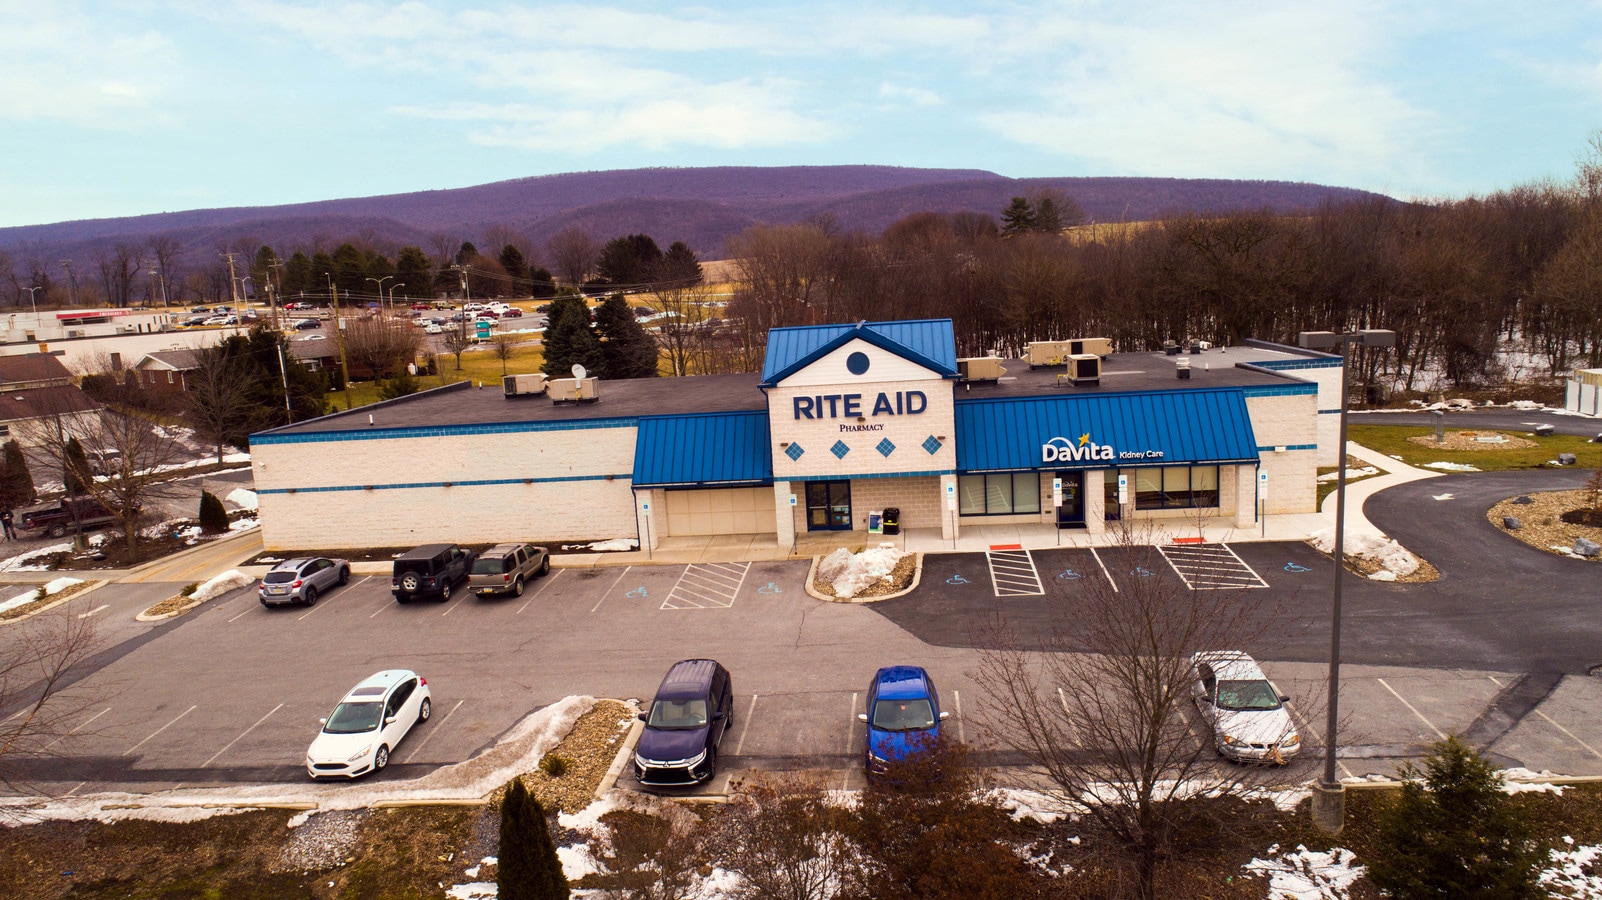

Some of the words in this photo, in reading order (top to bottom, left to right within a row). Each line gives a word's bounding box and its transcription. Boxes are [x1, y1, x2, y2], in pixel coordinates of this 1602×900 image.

[793, 394, 862, 420] RITE
[872, 391, 928, 416] AID
[1042, 437, 1114, 462] DaVita
[1120, 452, 1146, 460] Kidney
